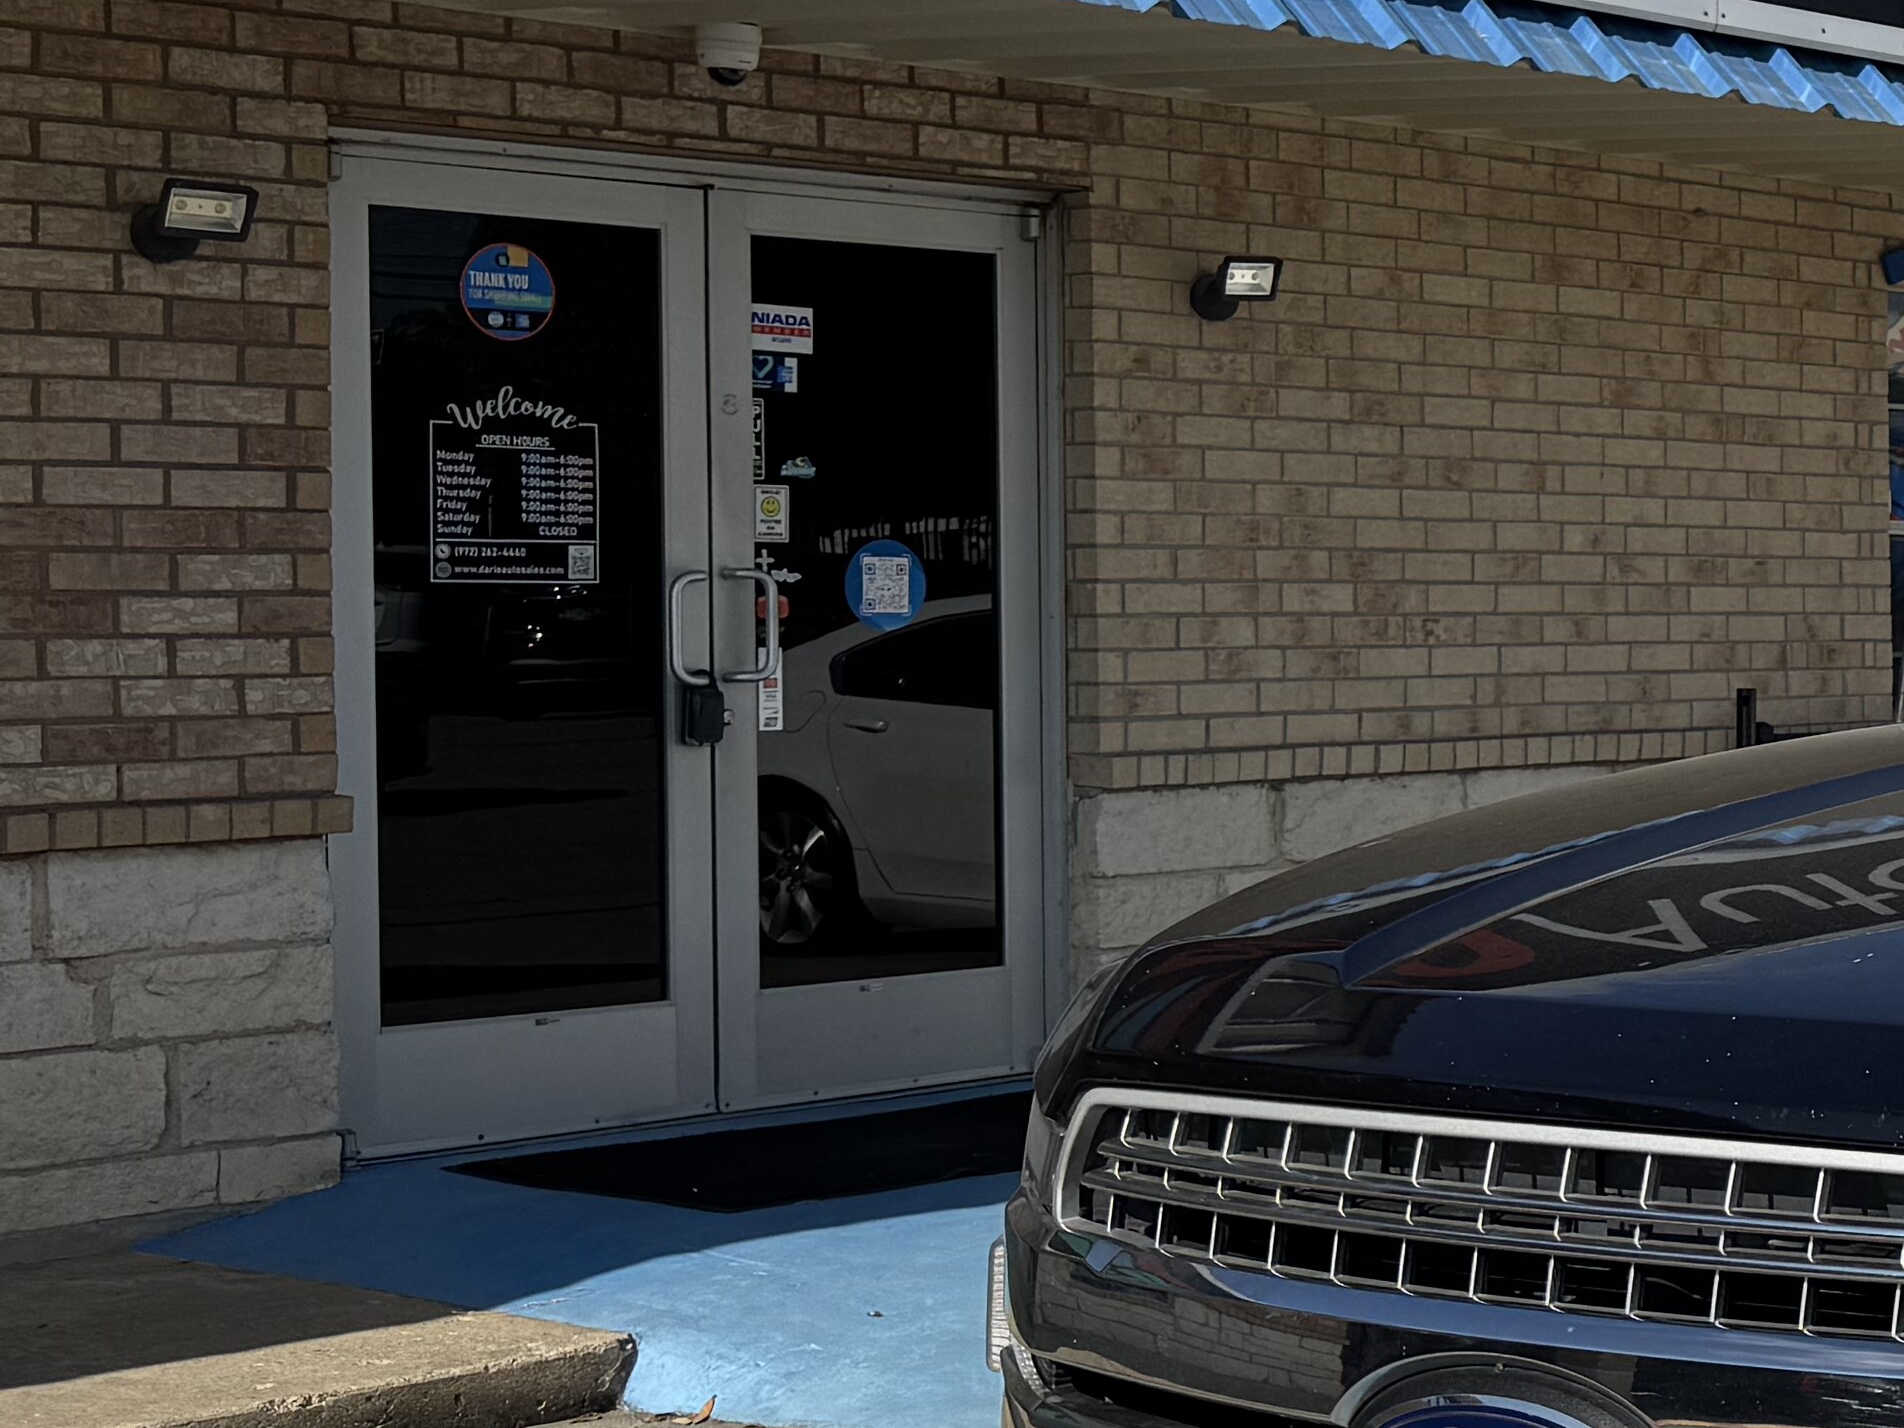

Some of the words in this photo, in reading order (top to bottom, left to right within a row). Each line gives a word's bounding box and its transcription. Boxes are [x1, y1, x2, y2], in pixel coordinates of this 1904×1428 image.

[468, 270, 505, 289] THANK
[507, 272, 529, 290] YOU
[752, 311, 811, 327] NIADA
[446, 385, 578, 430] Welcome
[481, 434, 511, 446] OPEN
[513, 435, 550, 447] HOURS
[436, 449, 475, 463] Monday
[436, 461, 477, 475] Tuesday
[436, 474, 492, 488] Wednesday
[436, 486, 482, 500] Thursday
[436, 498, 468, 512] Friday
[436, 511, 481, 524] Saturday
[436, 523, 474, 536] Sunday
[538, 526, 578, 536] CLOSED
